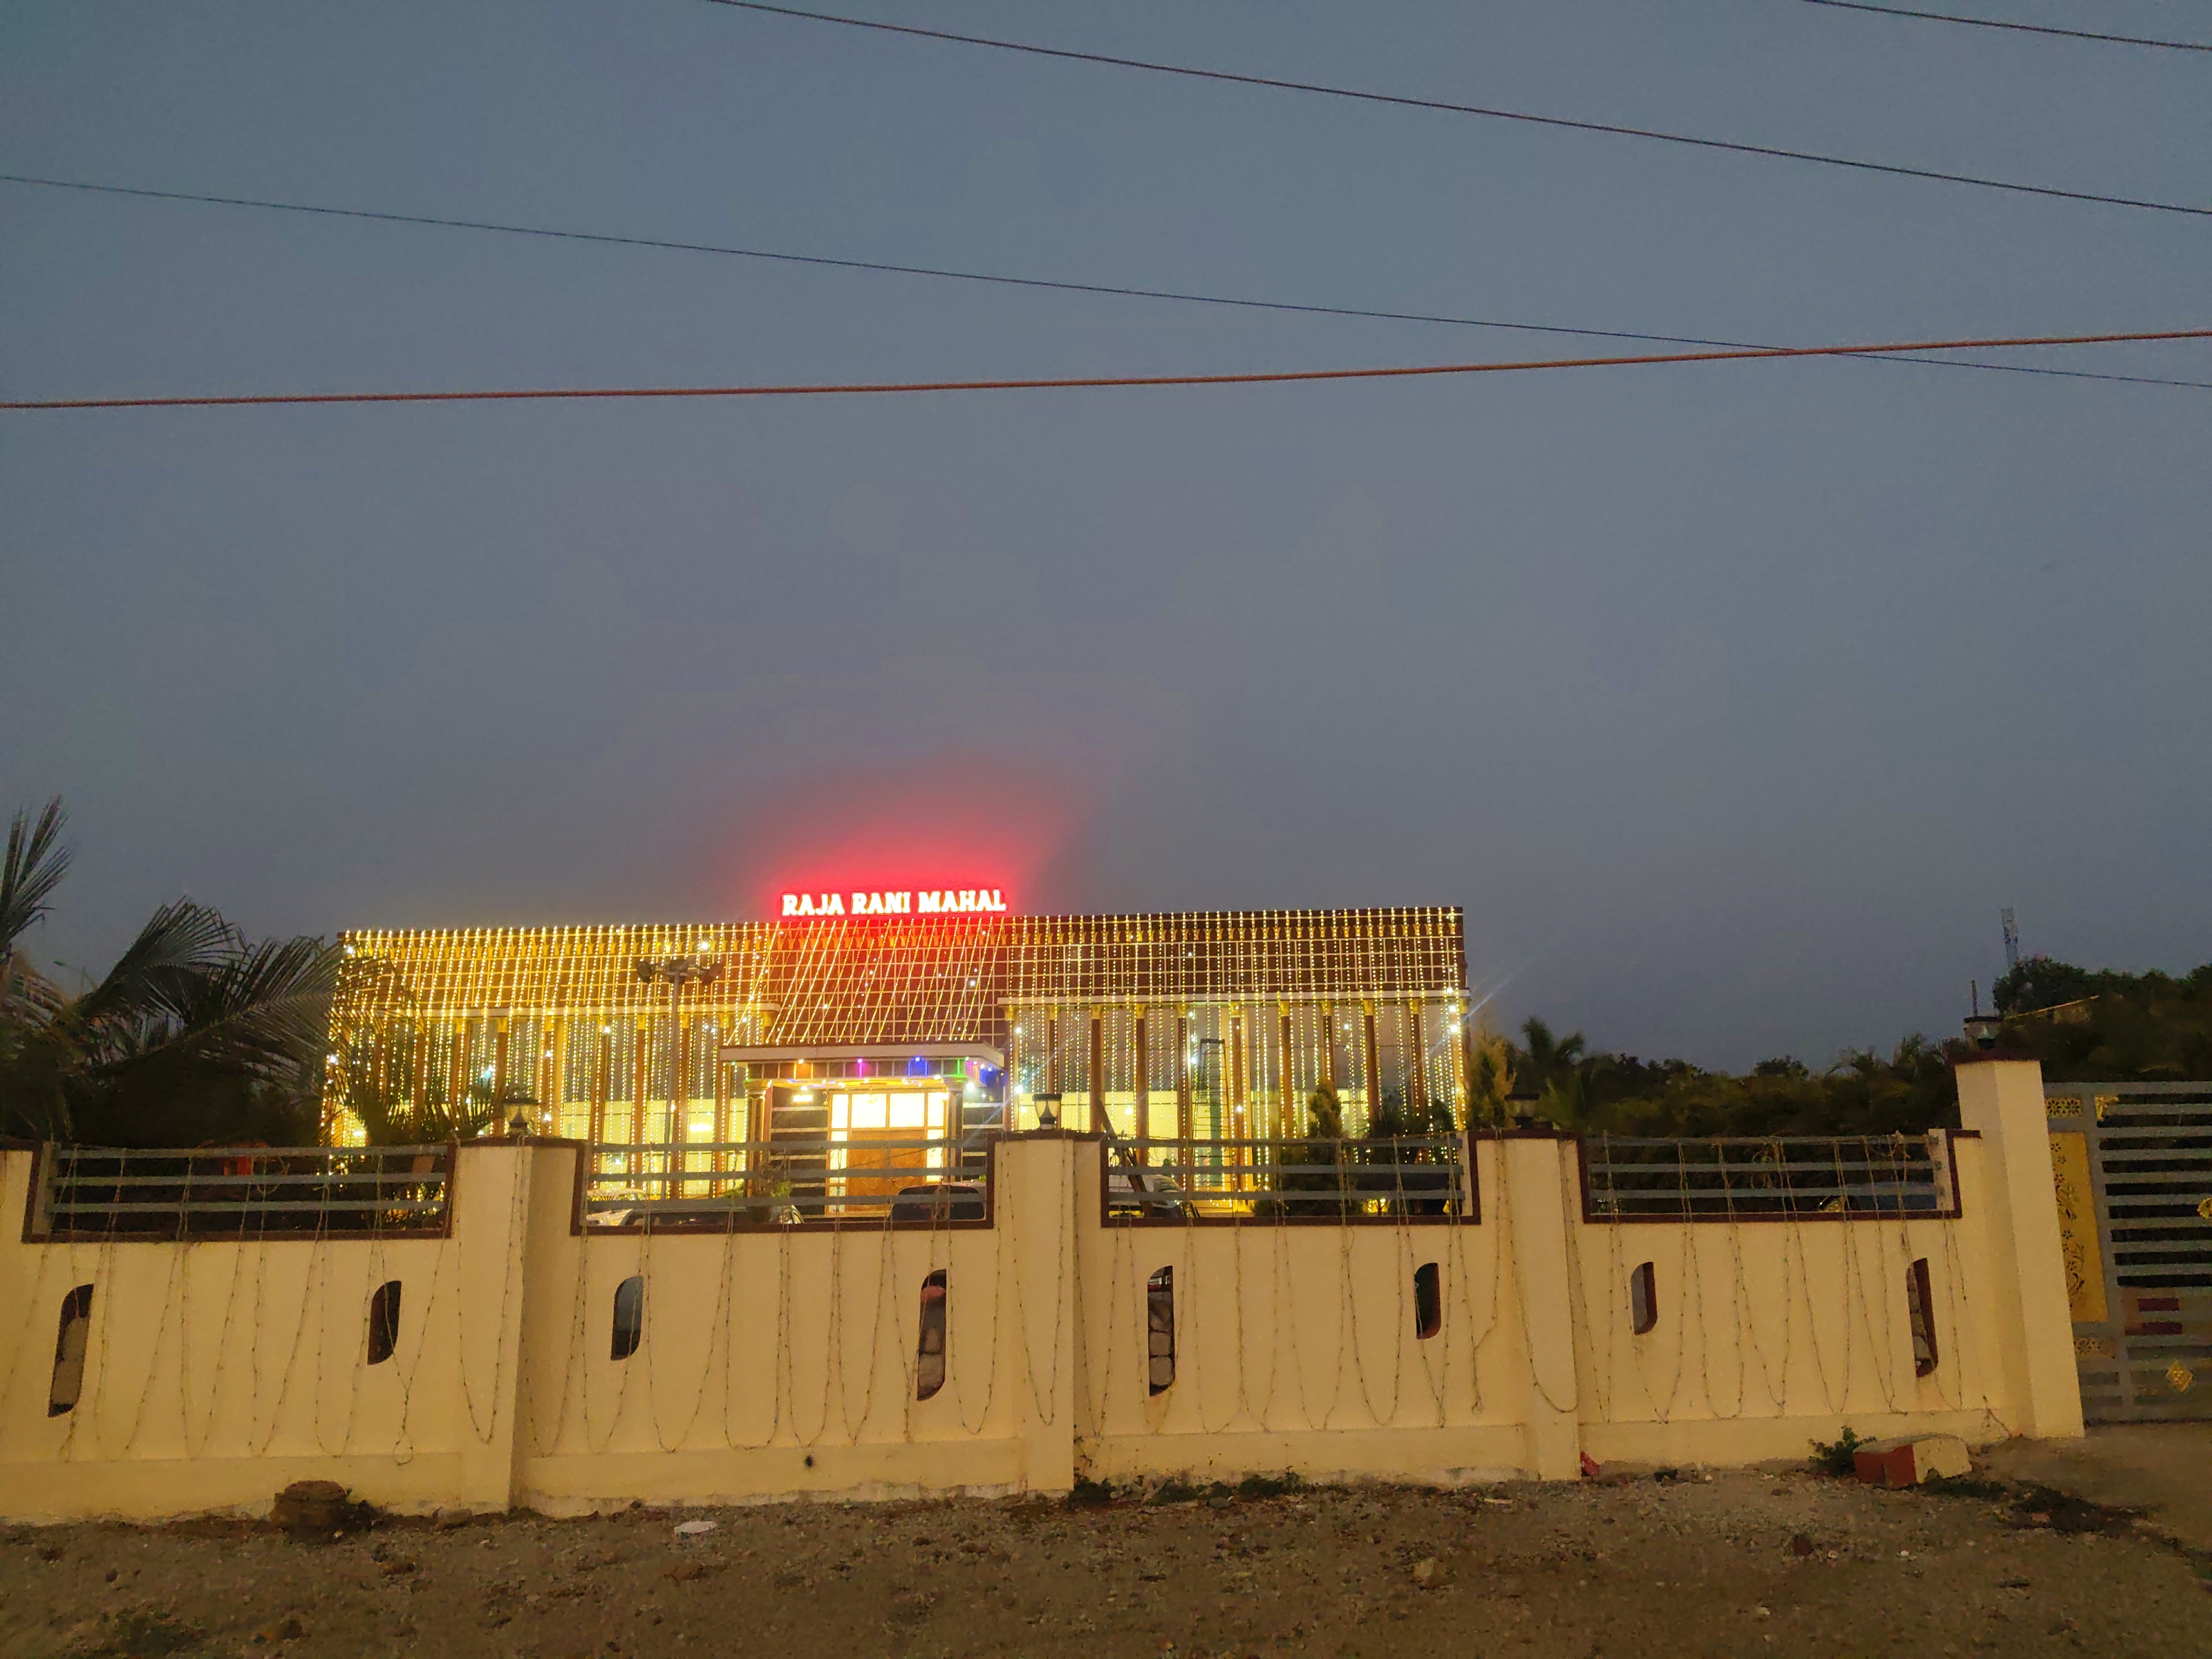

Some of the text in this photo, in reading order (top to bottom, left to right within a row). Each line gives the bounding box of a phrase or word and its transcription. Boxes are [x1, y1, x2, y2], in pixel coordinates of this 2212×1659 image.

[782, 889, 1006, 916] RAJA RANI MAHAL
